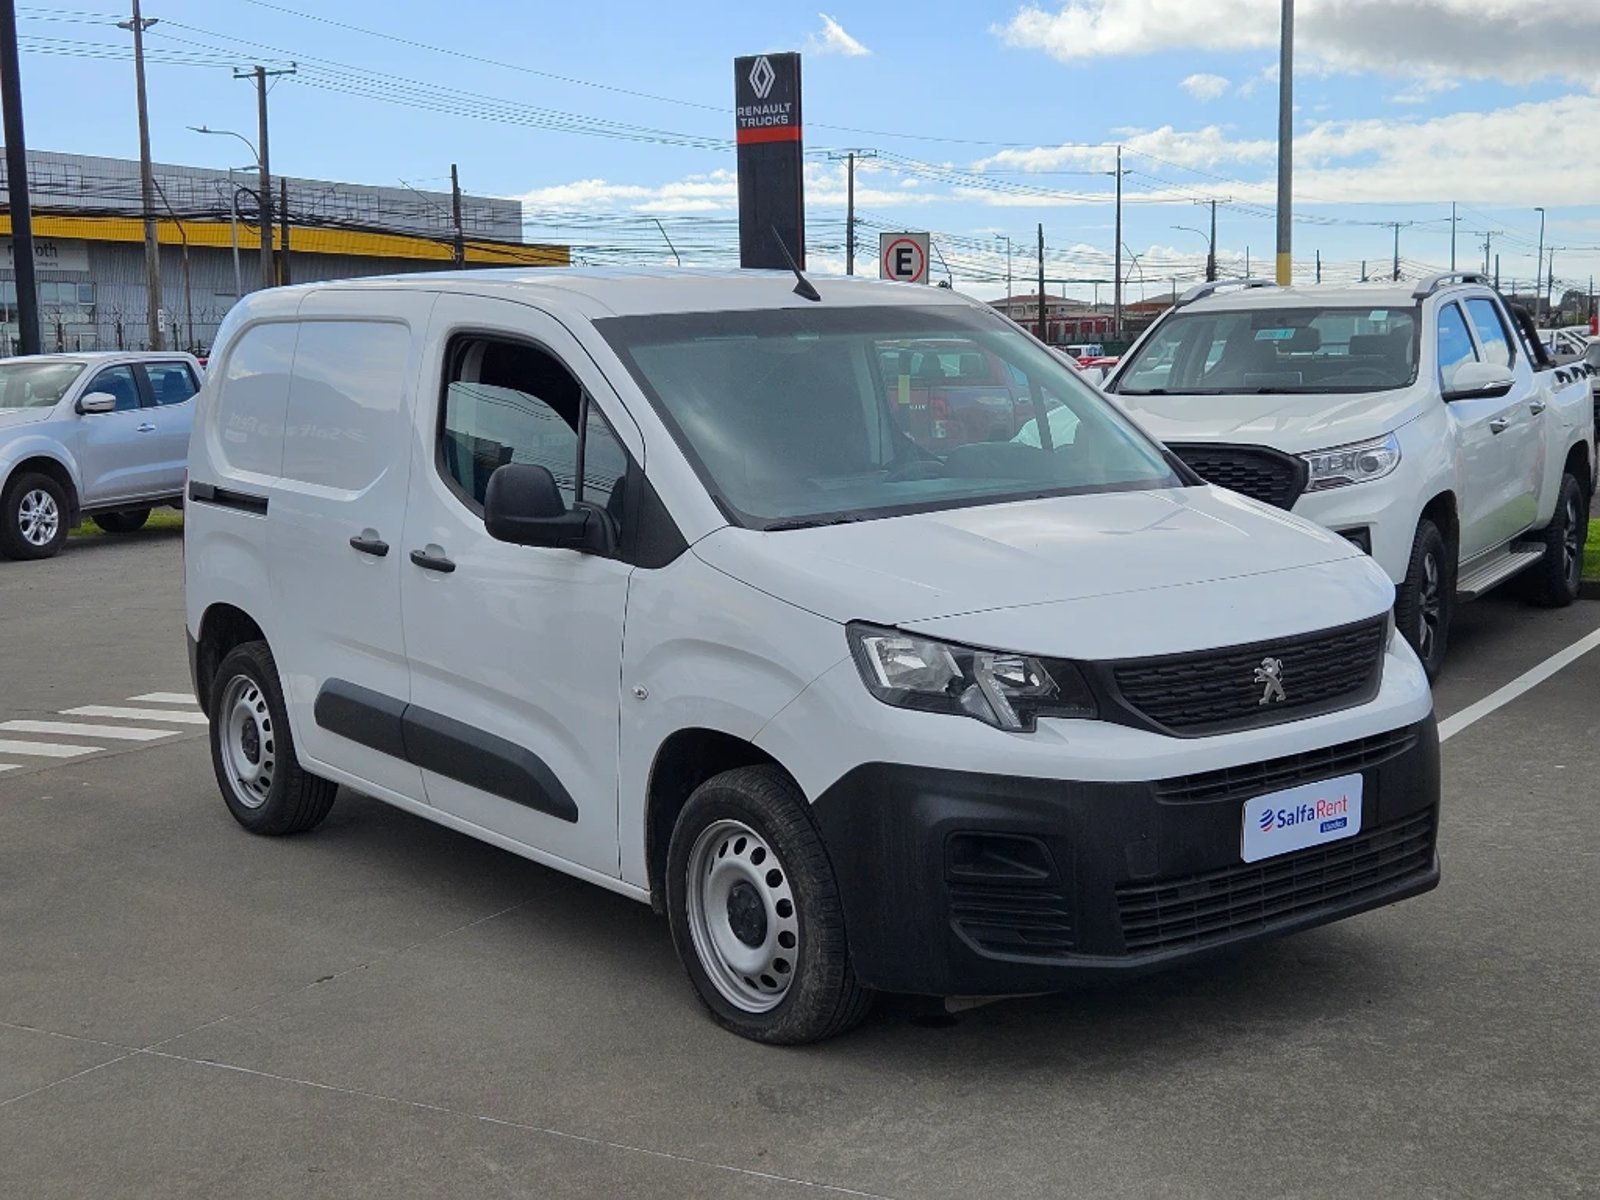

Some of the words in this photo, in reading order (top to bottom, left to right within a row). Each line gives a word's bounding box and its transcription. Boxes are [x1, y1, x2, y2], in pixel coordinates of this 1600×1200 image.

[737, 102, 792, 116] RENAULT
[740, 115, 789, 127] TRUCKS
[896, 248, 913, 275] E
[1277, 794, 1348, 829] SalfaRent
